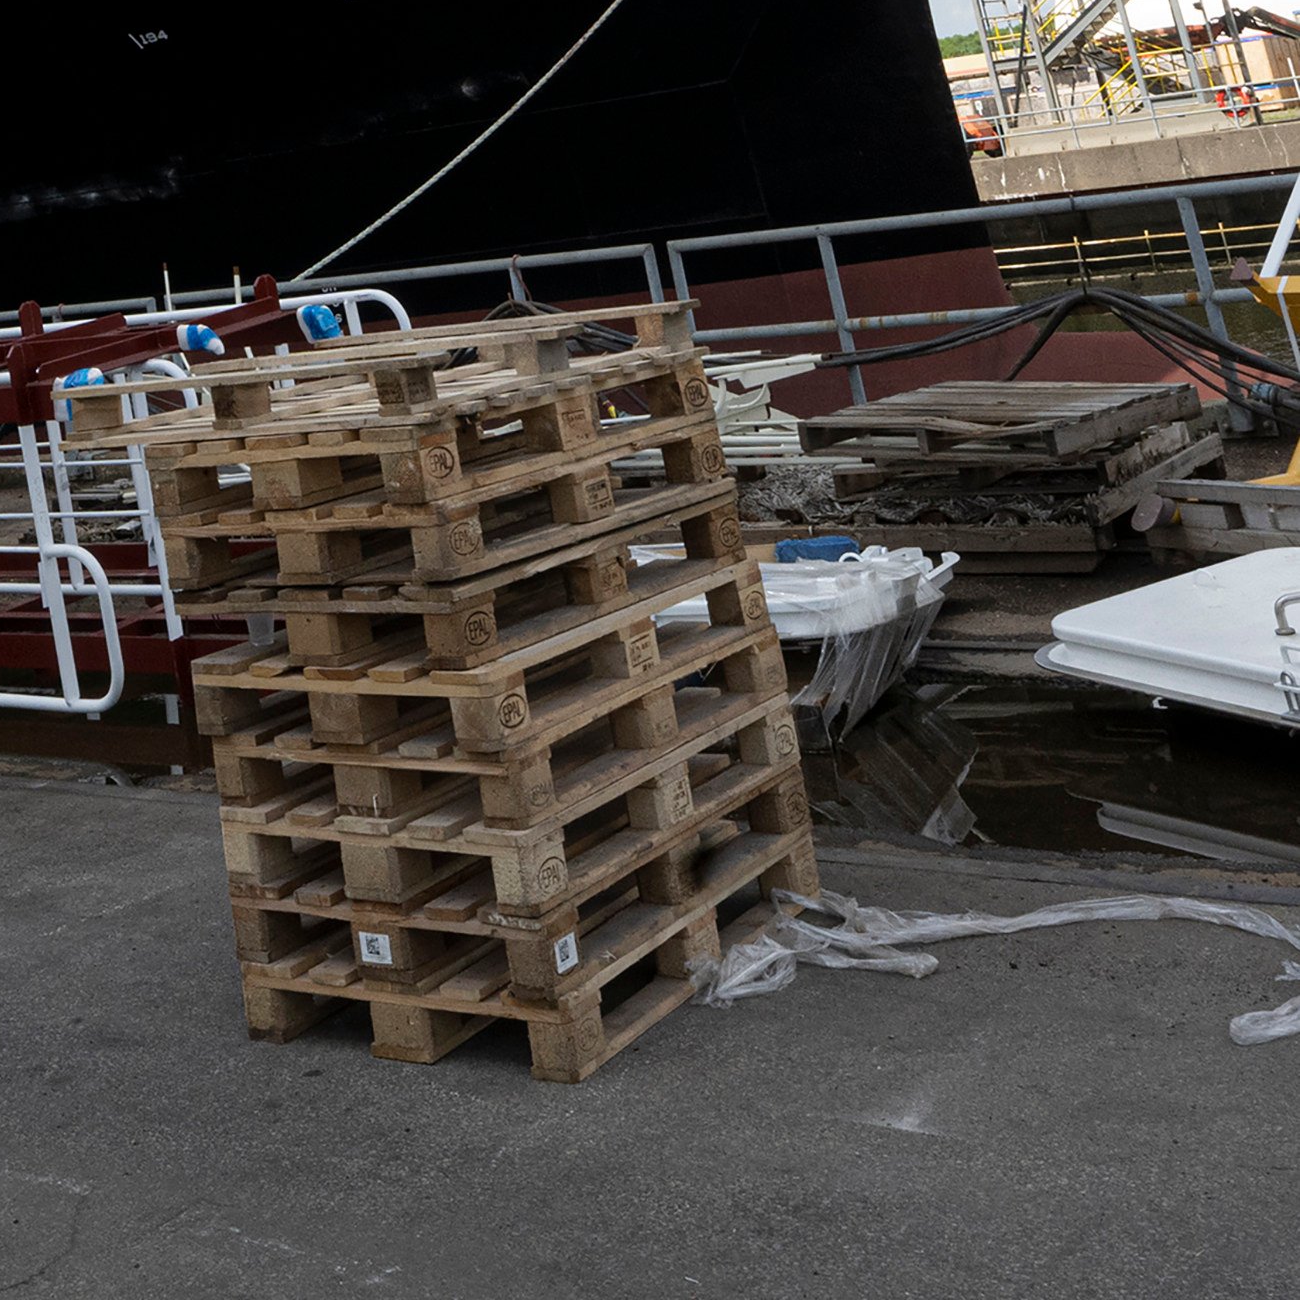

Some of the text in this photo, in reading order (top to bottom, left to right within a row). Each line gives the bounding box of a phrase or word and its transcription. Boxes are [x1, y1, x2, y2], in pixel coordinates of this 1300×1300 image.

[429, 452, 451, 474] EPAL
[452, 527, 476, 550] EPAL
[466, 618, 490, 640] EPAL
[502, 700, 525, 723] EPAL
